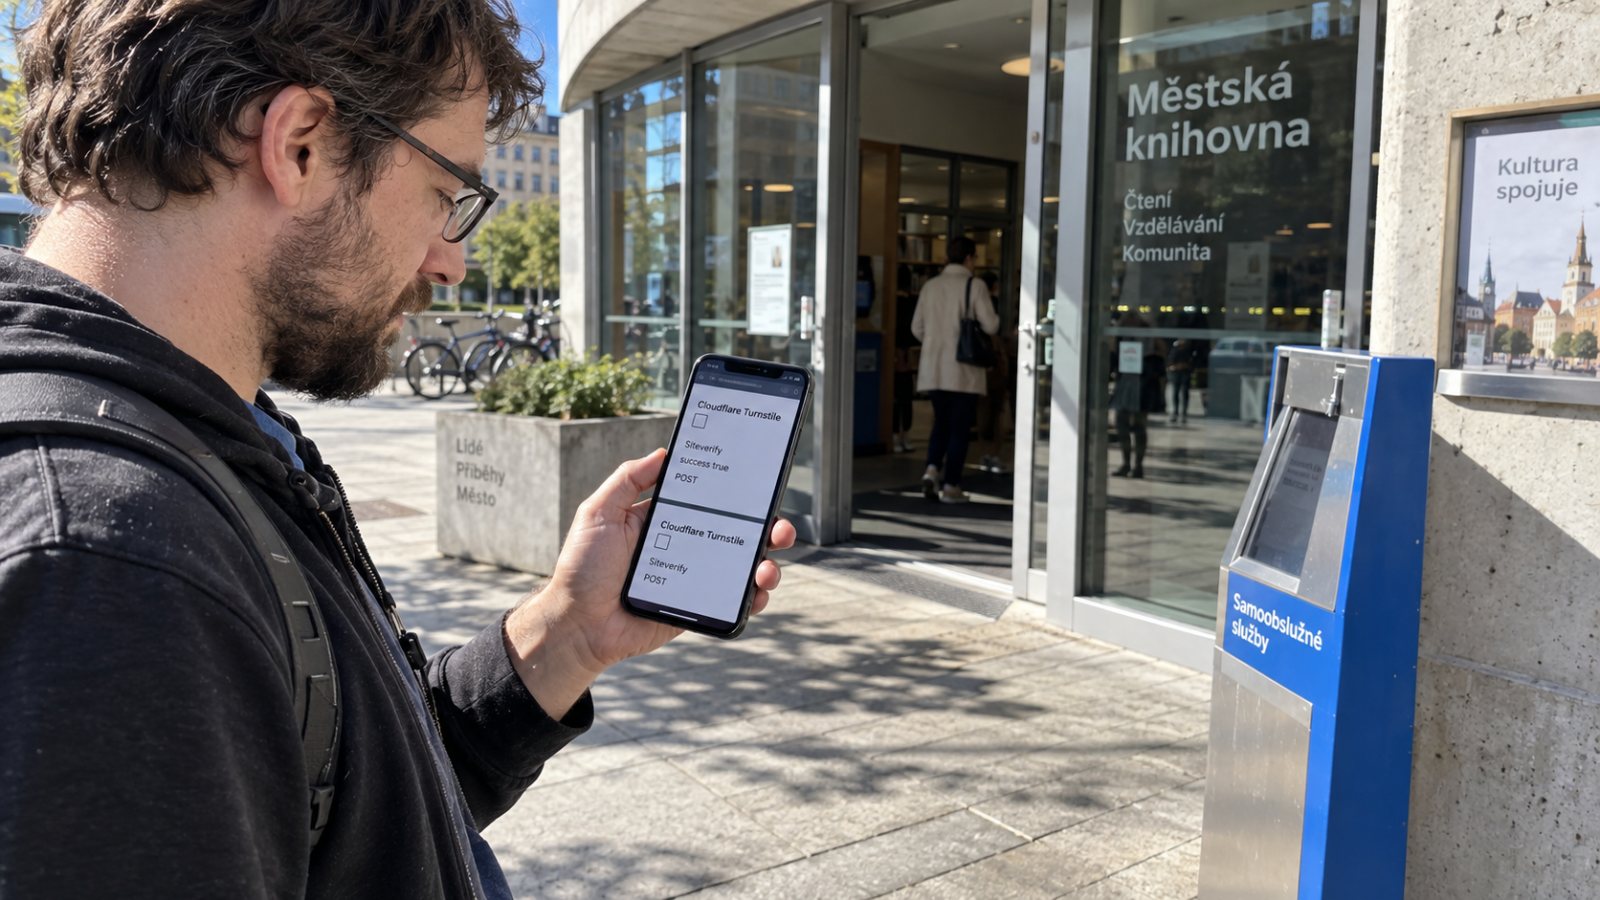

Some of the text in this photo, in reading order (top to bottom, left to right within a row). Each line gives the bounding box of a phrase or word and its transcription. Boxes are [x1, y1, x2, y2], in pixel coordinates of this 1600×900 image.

[1127, 60, 1293, 118] Městská
[1125, 118, 1310, 162] knihovna
[1498, 156, 1579, 176] Kultura
[1124, 189, 1172, 211] Čtení
[1496, 178, 1578, 203] spojuje
[1123, 212, 1225, 236] Vzdělávání
[1122, 243, 1211, 263] Komunita
[697, 400, 782, 422] Cloudflare Turnstile
[456, 438, 483, 456] Lidé
[684, 440, 723, 456] Siteverify
[679, 456, 729, 473] success true
[674, 472, 698, 484] POST
[456, 485, 497, 507] Město
[706, 530, 745, 547] Turnstile
[648, 557, 689, 575] Siteverify
[643, 573, 667, 586] POST
[1233, 592, 1323, 651] Samoobslužné
[1231, 619, 1270, 654] služby
